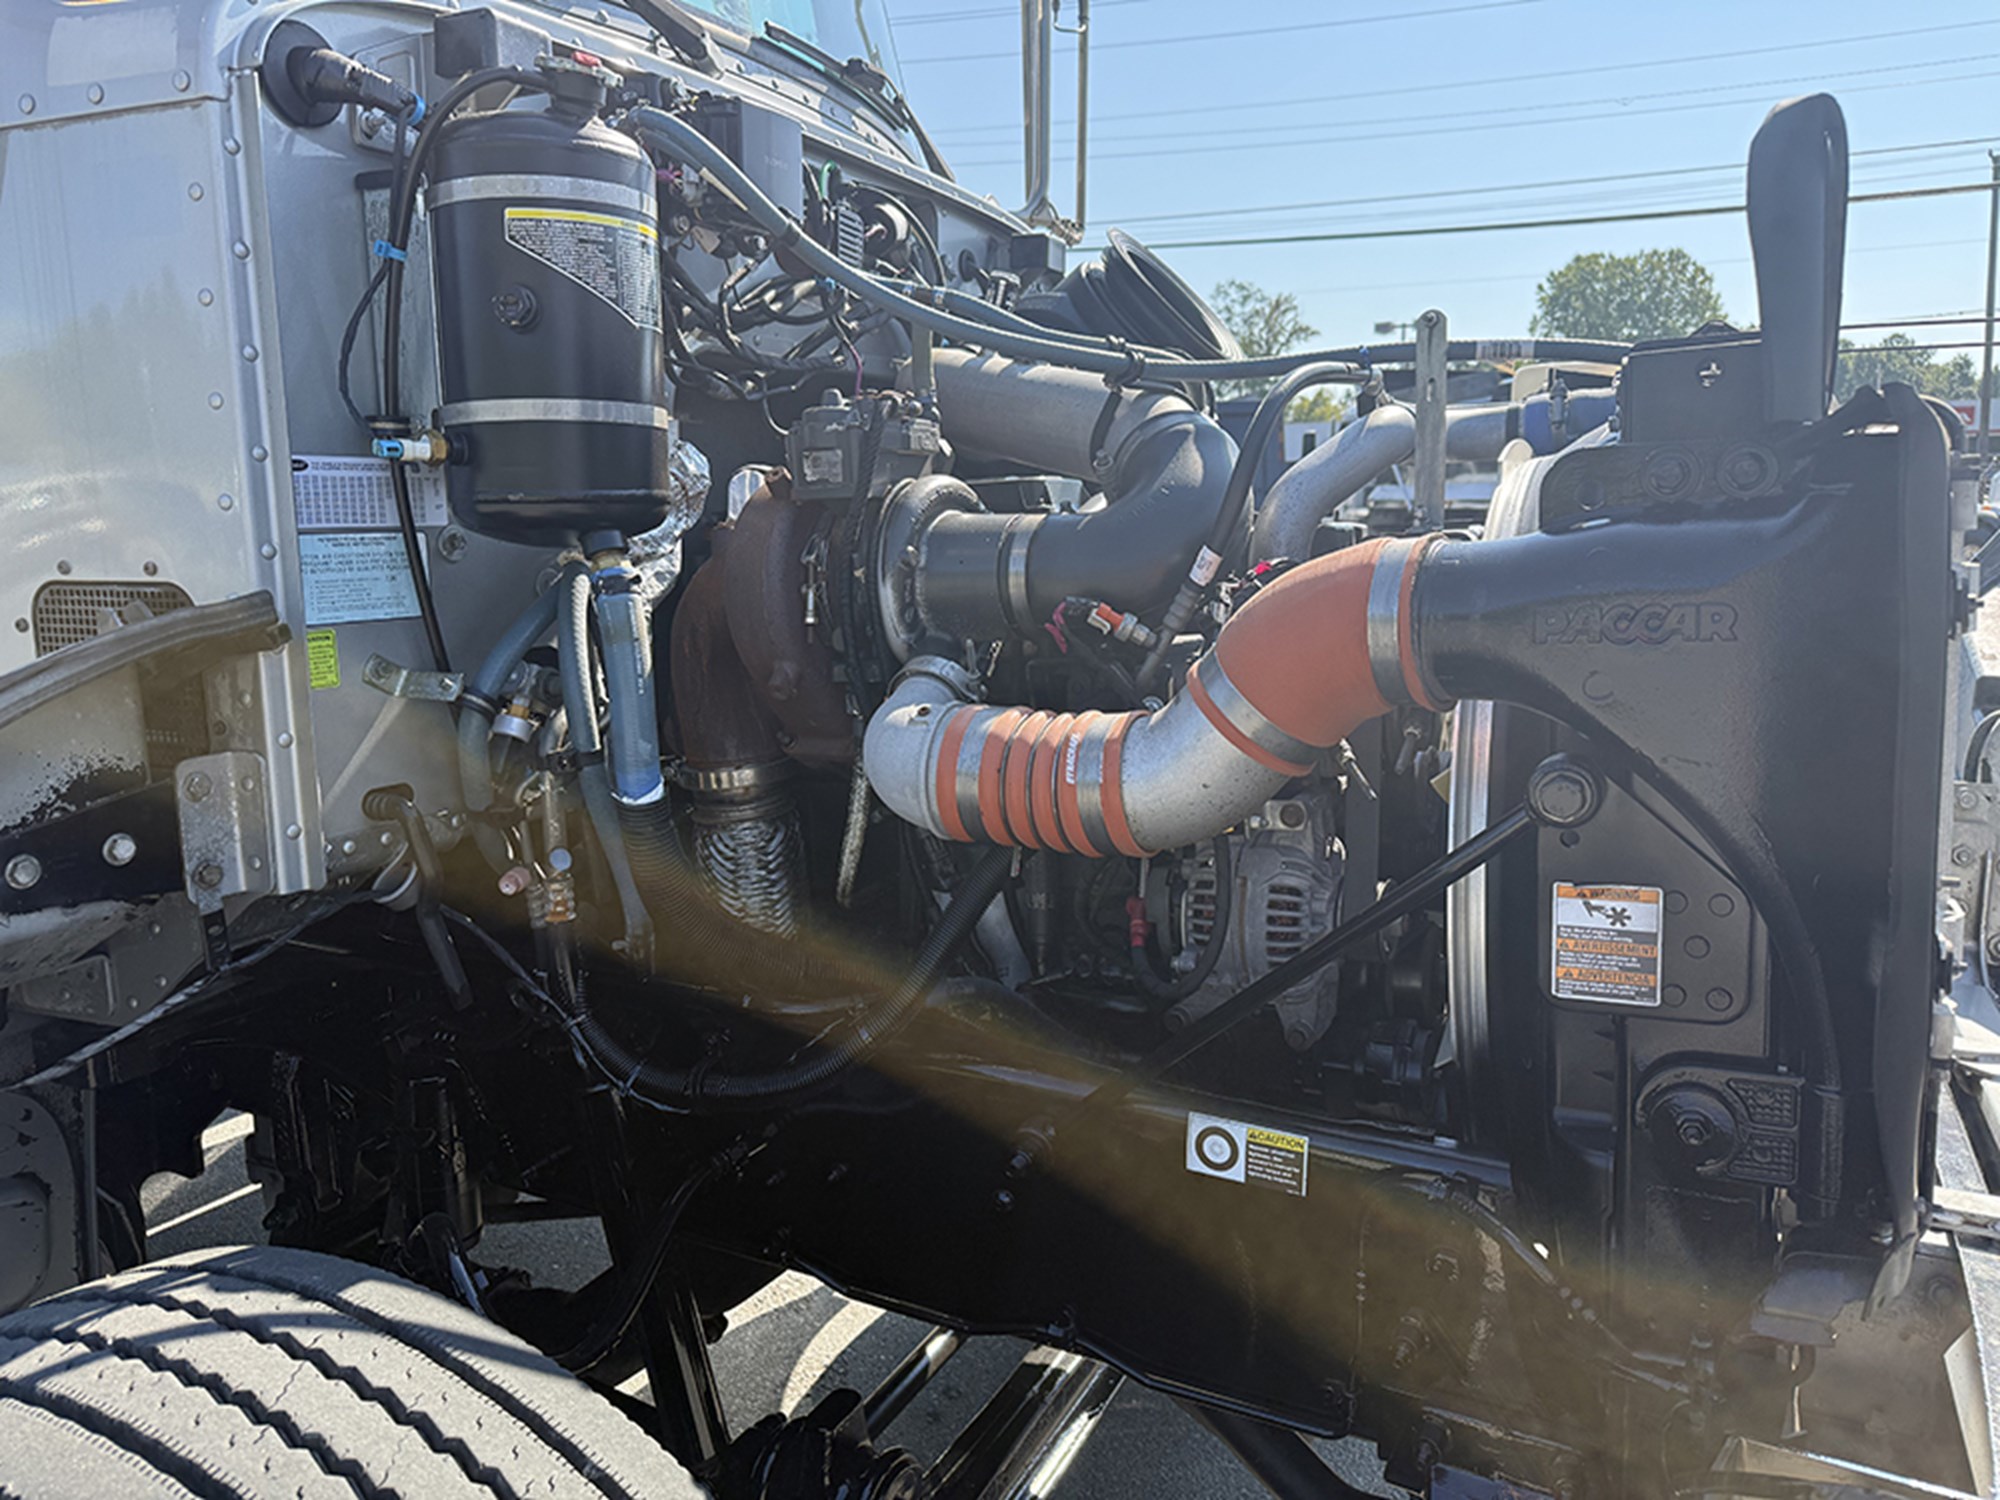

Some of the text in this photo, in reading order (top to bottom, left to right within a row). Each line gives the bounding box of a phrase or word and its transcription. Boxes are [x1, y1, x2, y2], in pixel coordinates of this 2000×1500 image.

[1533, 603, 1738, 645] PACCAR
[1573, 940, 1656, 956] AVERTISSEMENT
[1578, 968, 1650, 986] ADVERTENCIA
[1258, 1130, 1304, 1150] CAUTION
